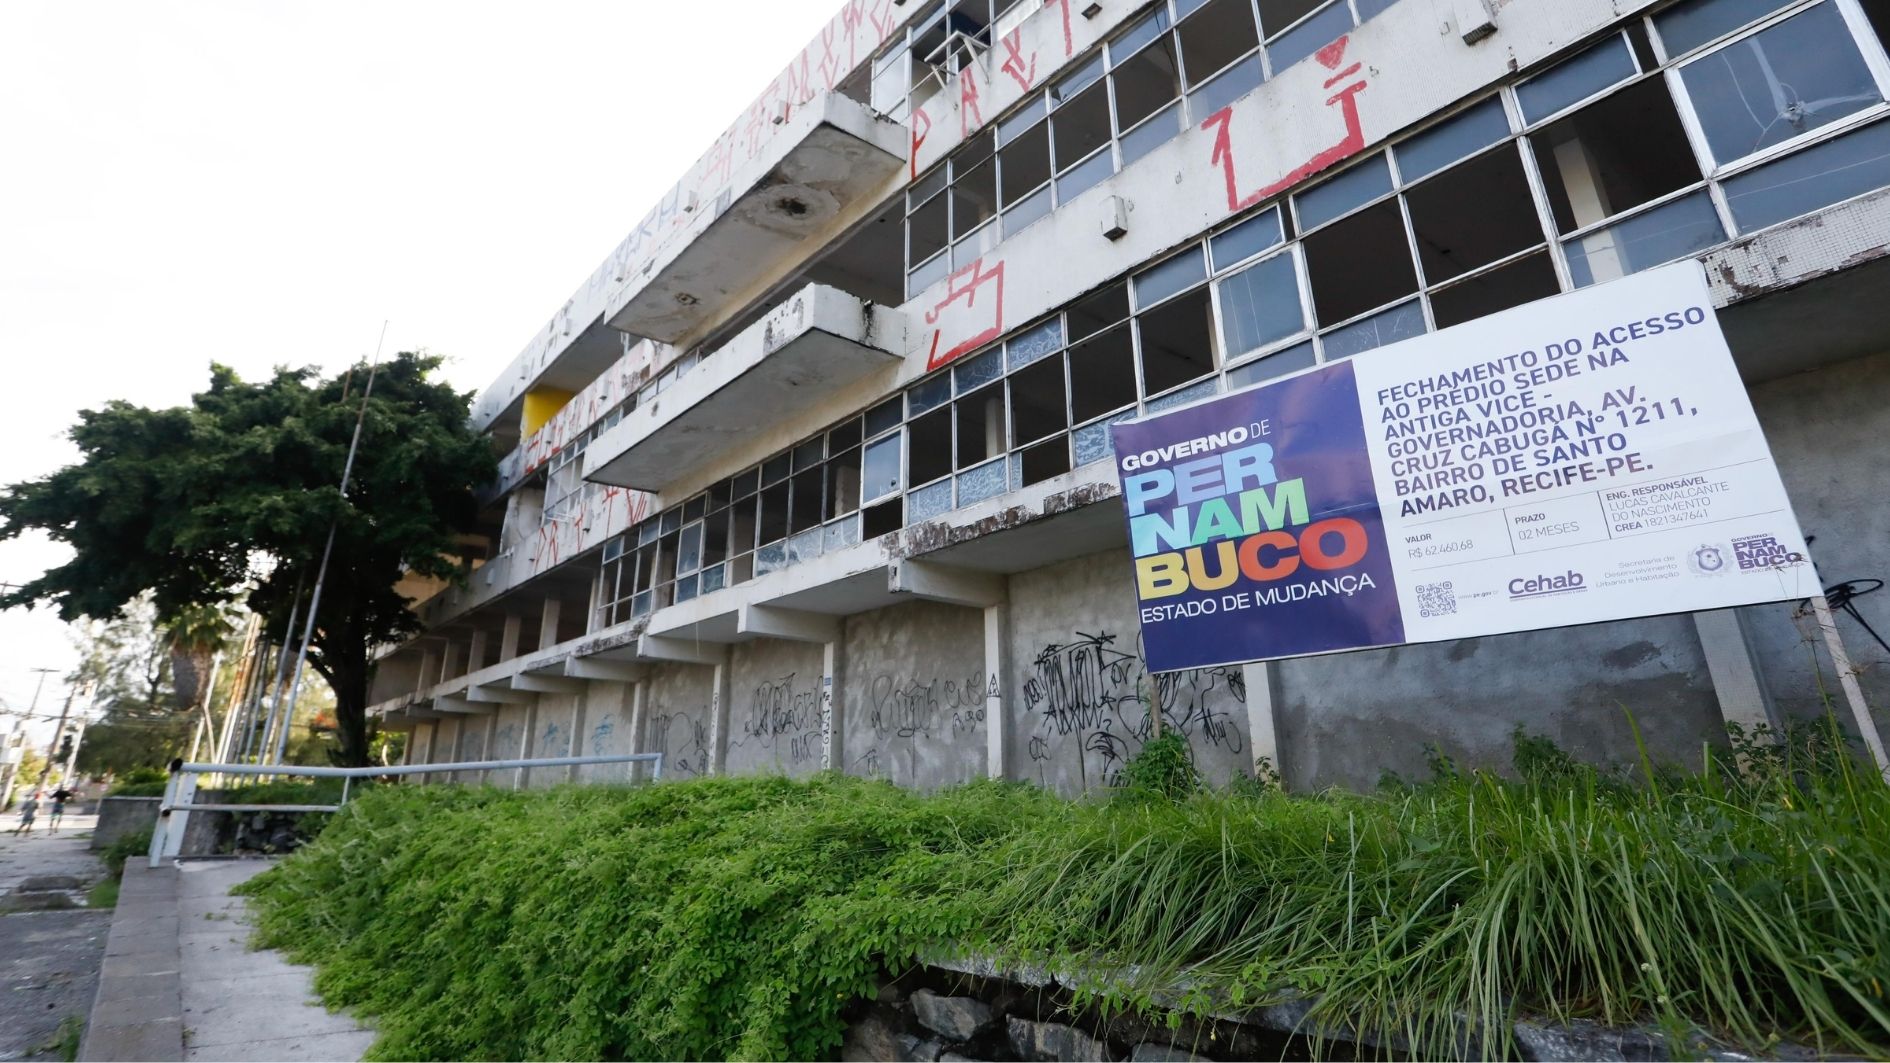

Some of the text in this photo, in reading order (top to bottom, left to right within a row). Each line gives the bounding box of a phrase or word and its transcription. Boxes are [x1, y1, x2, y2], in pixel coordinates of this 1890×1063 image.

[1377, 306, 1705, 405] FECHAMENTO DO ACESSO
[1381, 347, 1629, 423] AO PRÉDIO SEDE NA
[1385, 406, 1471, 441] ANTIGA
[1476, 390, 1536, 419] VICE
[1388, 386, 1646, 459] GOVERNADORIA, AV.
[1122, 419, 1271, 472] GOVERNO DE
[1391, 450, 1453, 477] CRUZ
[1461, 421, 1568, 462] CABUGÁ
[1616, 397, 1698, 428] 1211,
[1395, 432, 1627, 497] BAIRRO DE SANTO
[1124, 442, 1278, 517] PER
[1400, 452, 1653, 517] AMARO, RECIFE-PE.
[1606, 476, 1708, 501] ENG. RESPONSÁVEL
[1609, 482, 1730, 511] LUCAS CAVALCANTE
[1612, 496, 1710, 522] DO NASCIMENTO
[1130, 477, 1309, 558] NAM
[1515, 512, 1546, 524] PRAZO
[1519, 521, 1580, 541] 02 MESES
[1615, 521, 1643, 532] CREA
[1405, 533, 1432, 544] VALOR
[1731, 533, 1768, 542] GOVERNO
[1733, 537, 1777, 551] PER
[1736, 544, 1787, 560] NAM
[1135, 517, 1368, 601] BUCO
[1408, 547, 1423, 559] R$
[1739, 552, 1802, 569] BUCO
[1508, 570, 1584, 595] Cehab
[1141, 572, 1376, 623] ESTADO DE MUDANÇA
